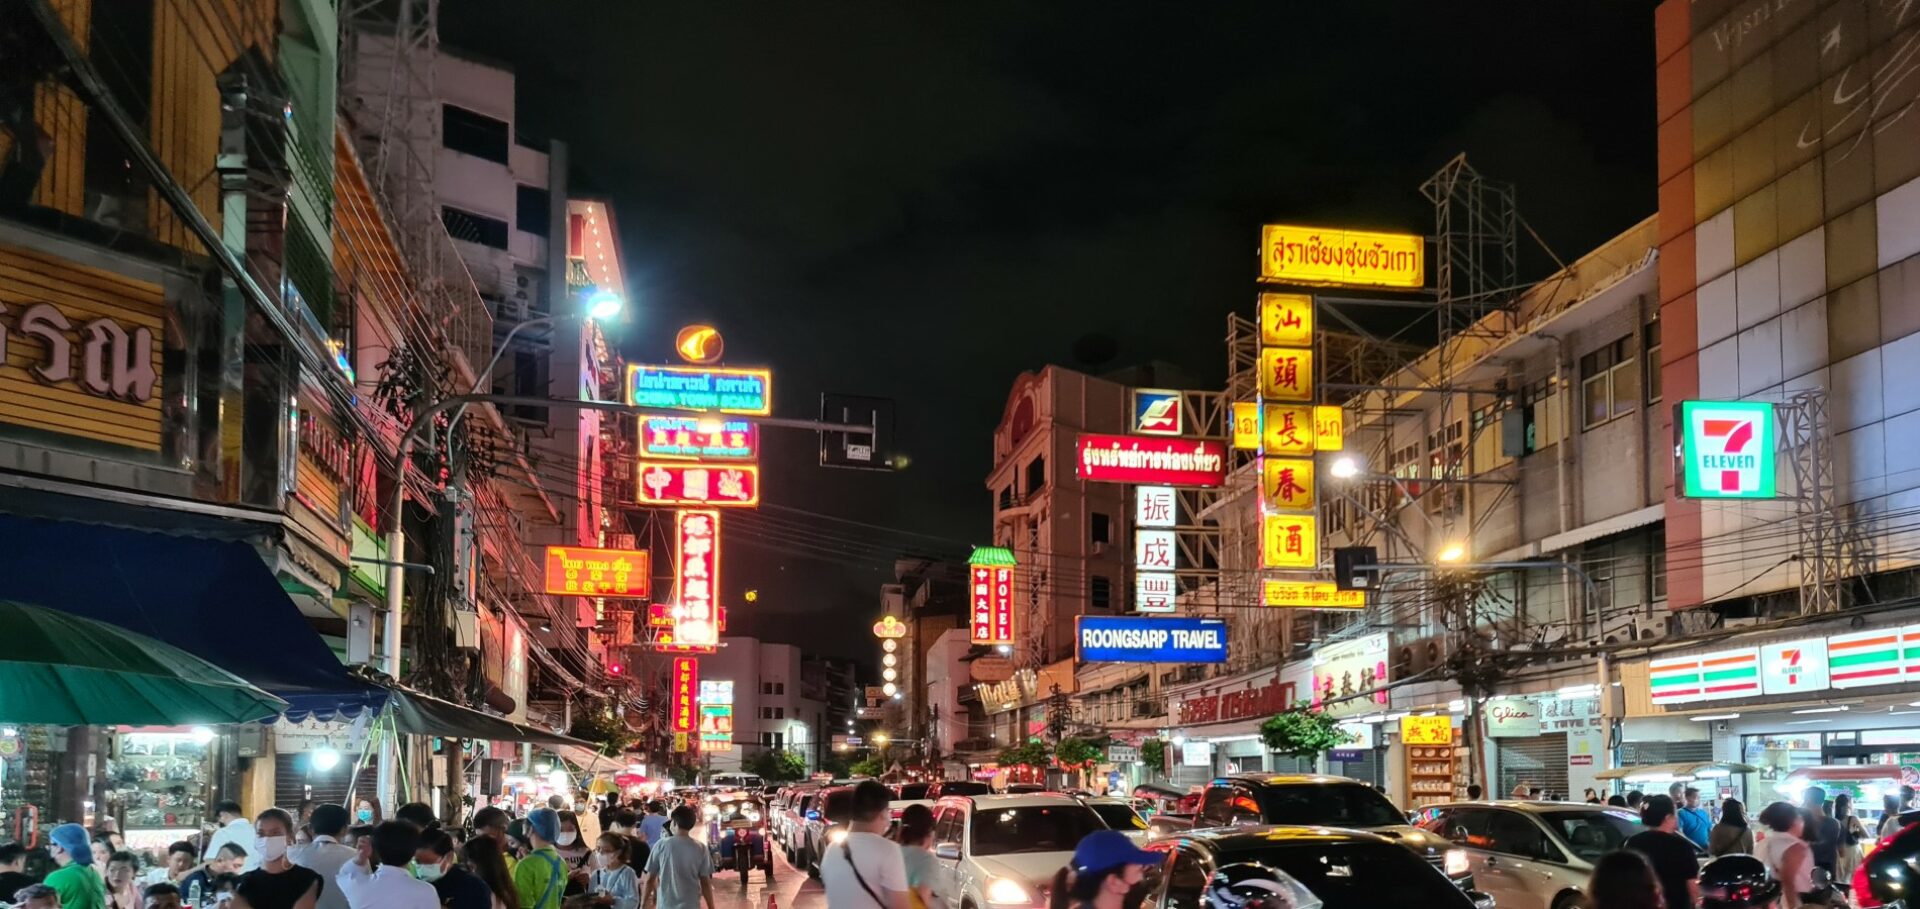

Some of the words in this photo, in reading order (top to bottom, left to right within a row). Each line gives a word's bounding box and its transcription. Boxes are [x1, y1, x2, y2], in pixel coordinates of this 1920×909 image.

[635, 390, 677, 405] CHINA
[679, 391, 719, 407] TOWN
[720, 394, 763, 409] SCALA
[1273, 303, 1306, 556] 汕頭長春酒
[1703, 419, 1753, 491] 7
[645, 466, 748, 500] 中國城
[1143, 493, 1170, 608] 振成豐
[976, 569, 989, 639] 中國大酒店
[998, 570, 1008, 639] HOTEL
[1082, 628, 1168, 648] ROONGSARP
[1171, 630, 1221, 649] TRAVEL
[1781, 650, 1801, 684] 7
[1493, 705, 1534, 723] Glico
